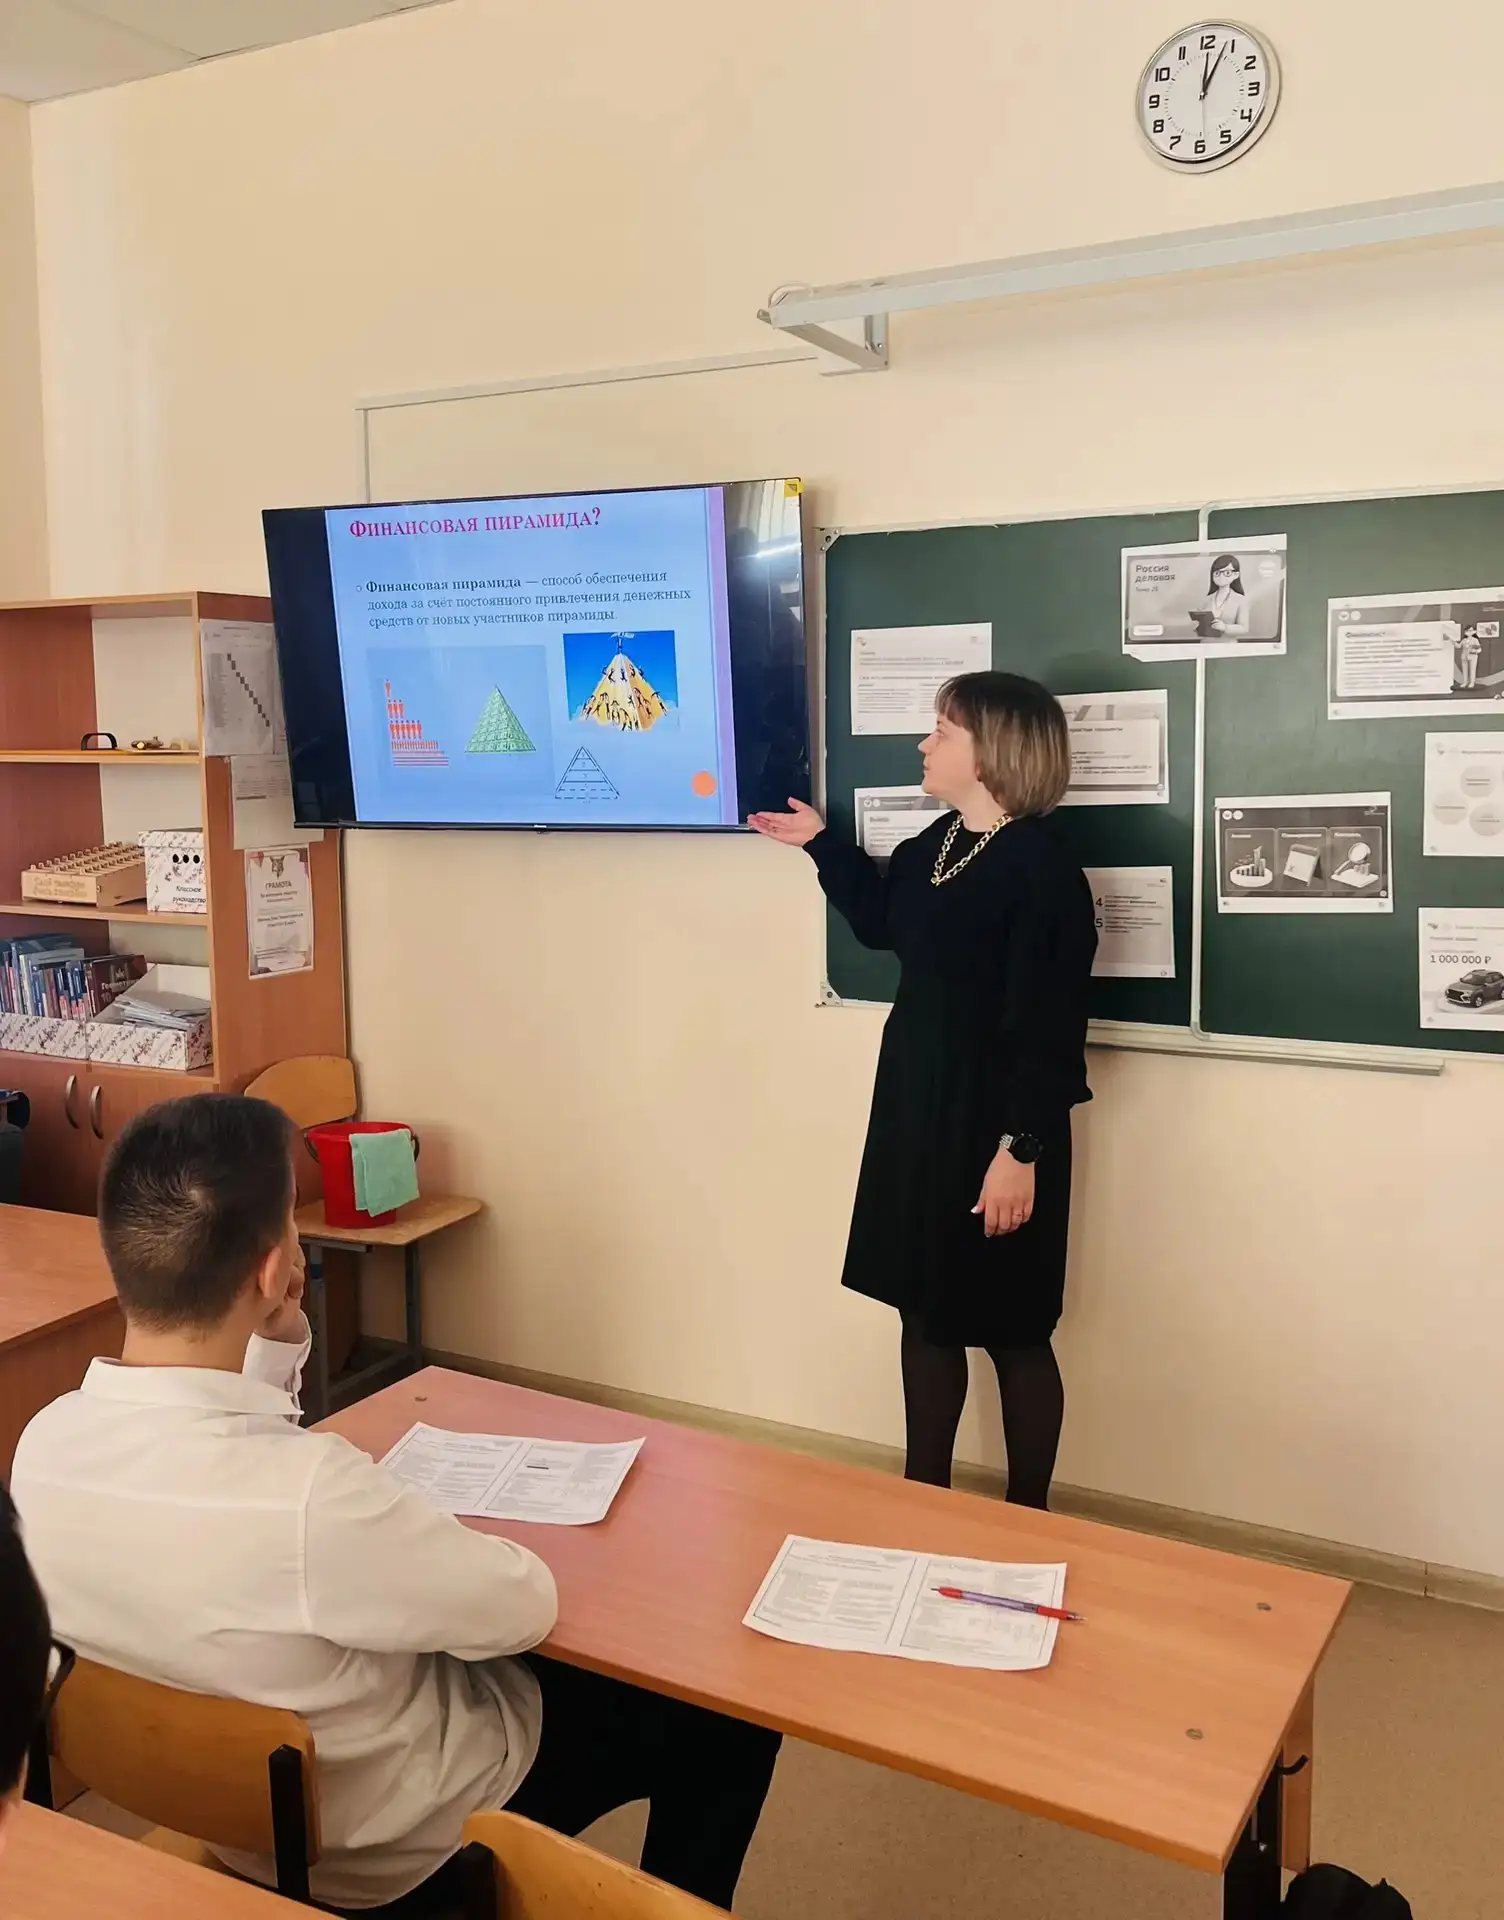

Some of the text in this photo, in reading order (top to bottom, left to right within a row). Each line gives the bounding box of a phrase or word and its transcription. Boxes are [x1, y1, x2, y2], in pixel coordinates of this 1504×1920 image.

[1200, 35, 1216, 50] 12
[1231, 39, 1236, 53] 1
[1178, 46, 1186, 60] 11
[1244, 55, 1256, 70] 2
[1155, 67, 1170, 82] 10
[1248, 81, 1260, 96] 3
[1149, 94, 1160, 109] 9
[1240, 108, 1252, 122] 4
[1153, 119, 1164, 133] 8
[1169, 135, 1181, 150] 7
[1219, 130, 1231, 144] 5
[1194, 140, 1206, 154] 6
[350, 506, 601, 538] ФИНАНСОВАЯ ПИРАМИДА?
[1135, 565, 1170, 573] Россия
[366, 580, 449, 594] Финансовая
[452, 577, 522, 592] пирамида
[541, 572, 583, 587] способ
[585, 570, 667, 585] обеспечения
[1135, 574, 1176, 583] деловая
[368, 589, 692, 611] дохода за счёт постоянного привлечения денежных
[369, 609, 618, 628] средств от новых участников пирамиды.
[265, 880, 292, 889] ГРАМОТА
[1095, 897, 1103, 907] 4
[1095, 918, 1103, 928] 5
[1430, 954, 1436, 963] 1
[1439, 955, 1459, 963] 000
[1461, 955, 1482, 964] 000
